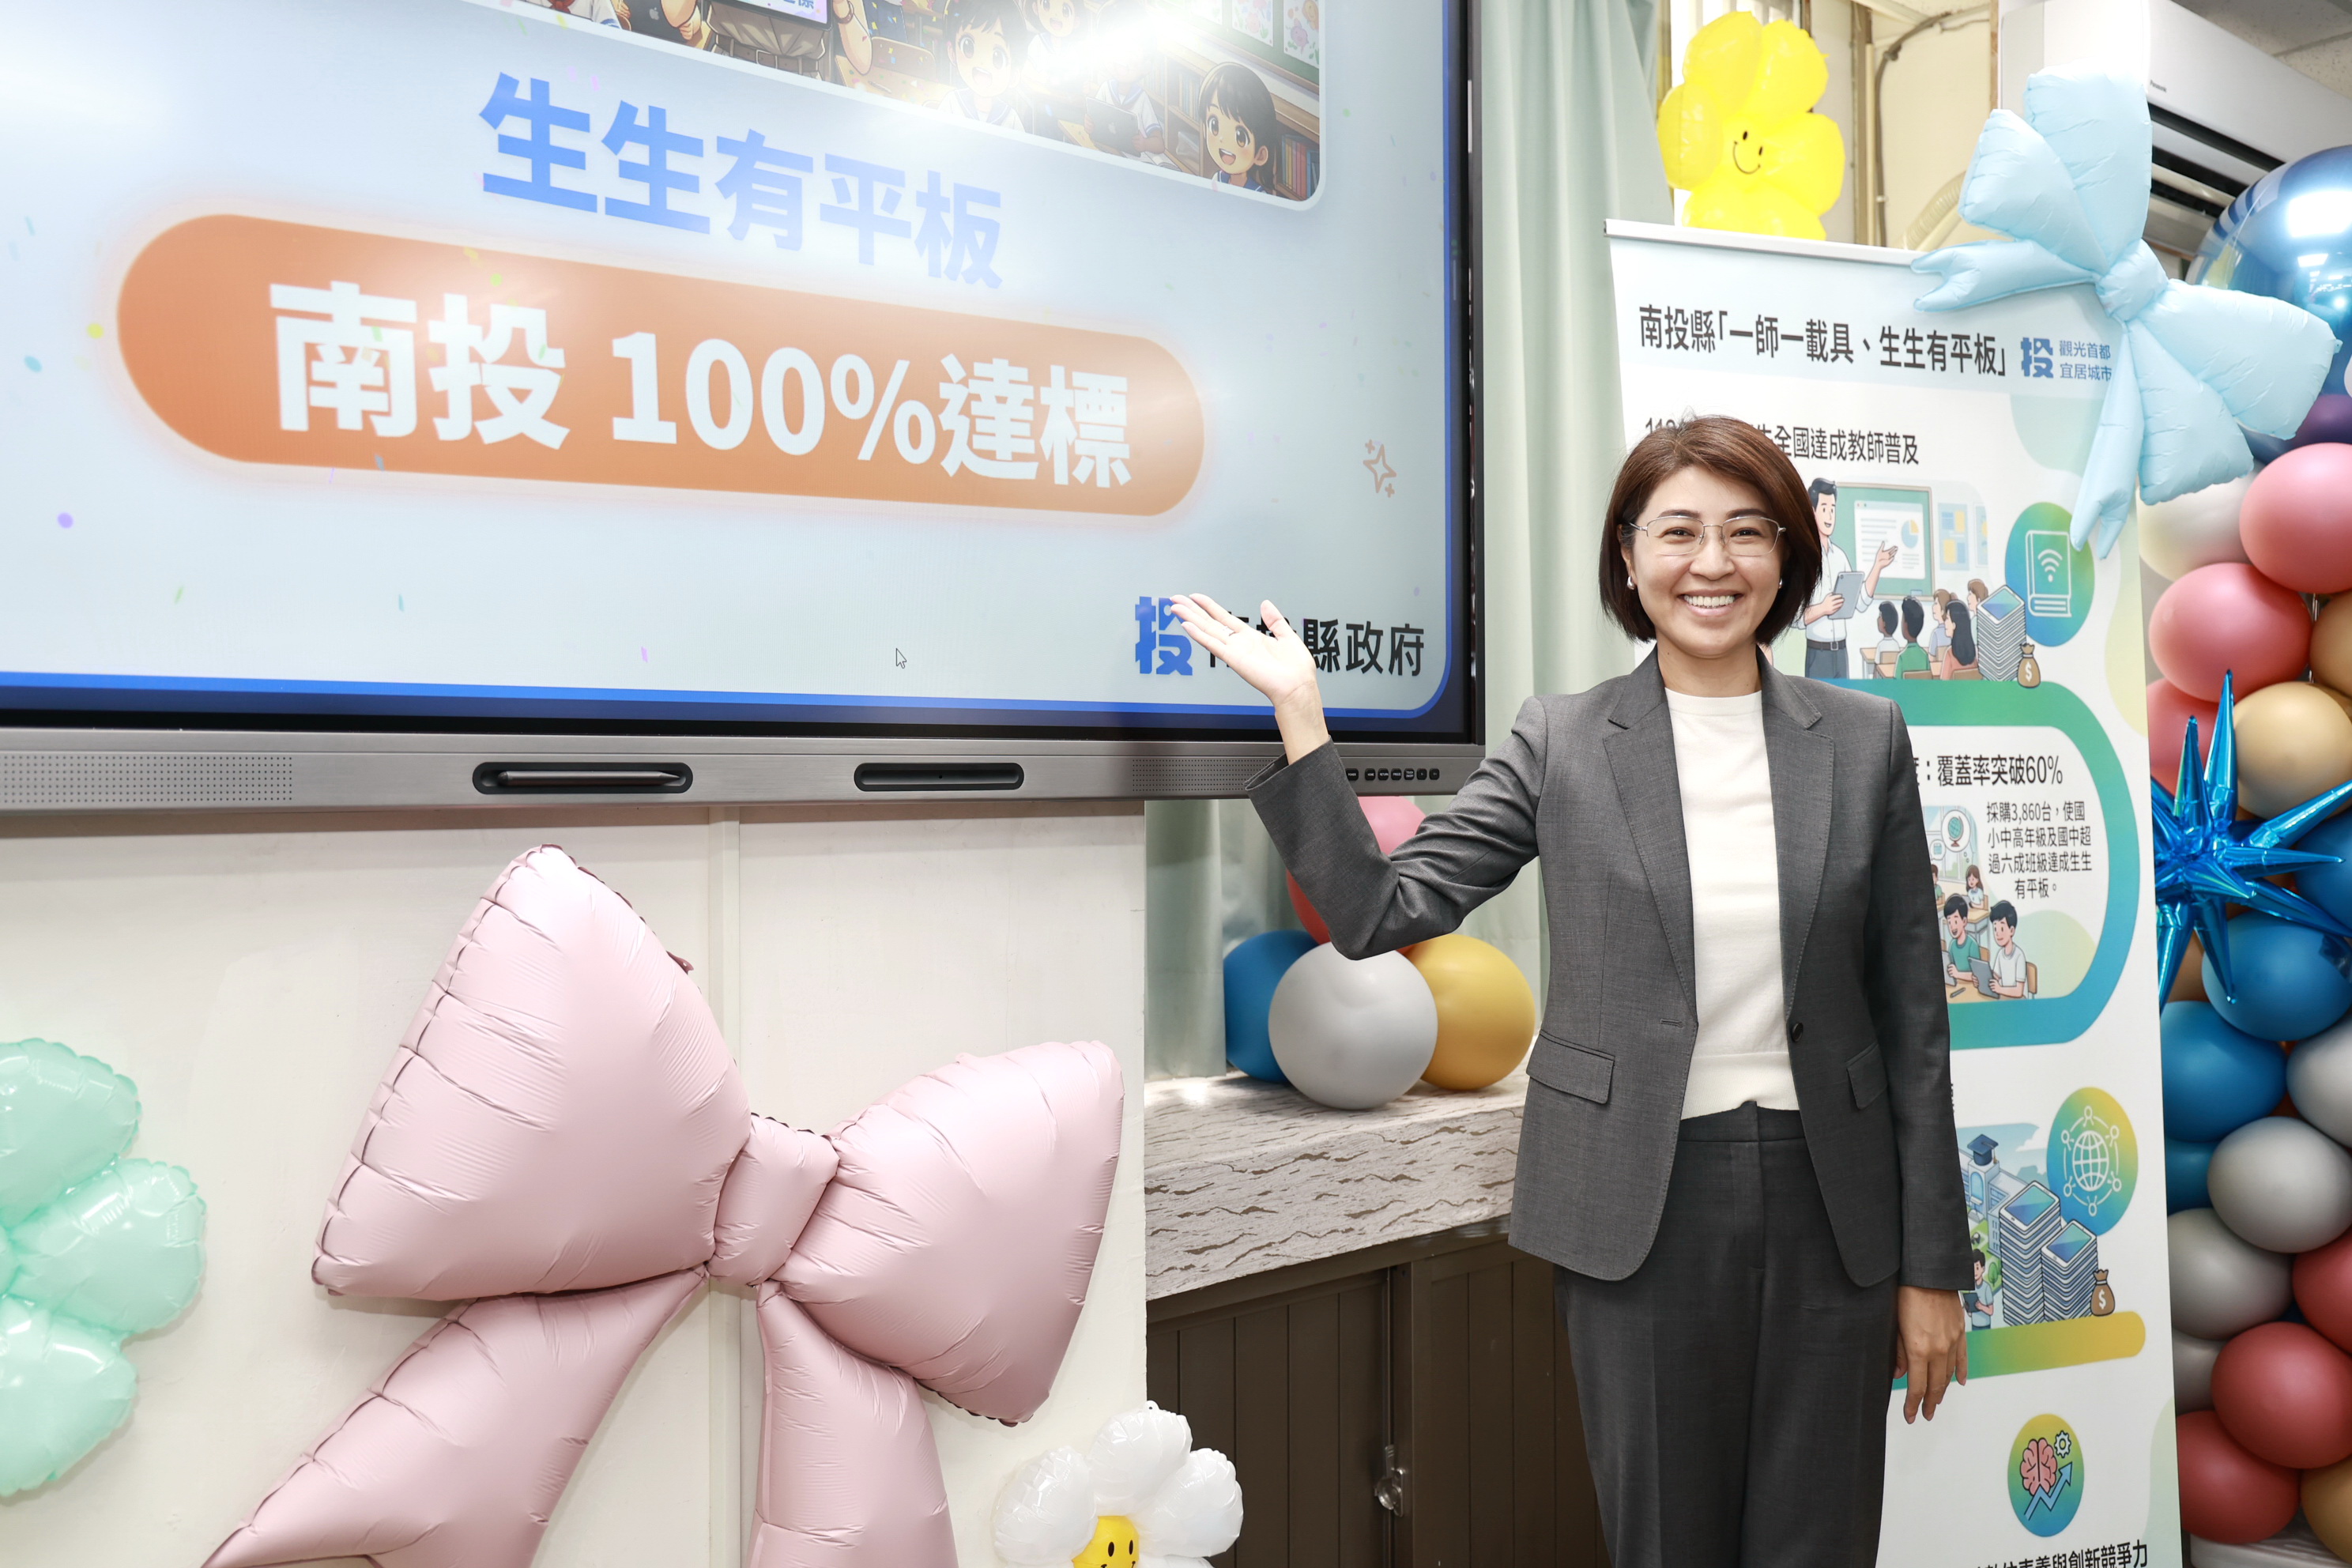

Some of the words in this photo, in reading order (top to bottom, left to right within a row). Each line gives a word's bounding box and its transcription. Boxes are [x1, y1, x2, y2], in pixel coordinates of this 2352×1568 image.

[479, 72, 1003, 289] 生生有平板
[1639, 304, 2006, 376] 南投縣「一師一載具、生生有平板」
[2059, 340, 2111, 360] 觀光首都
[270, 280, 569, 450] 南投
[612, 331, 1133, 488] 100%達標
[2060, 362, 2112, 382] 宜居城市
[1756, 424, 1919, 465] 全國達成教師普及
[1209, 611, 1425, 677] 縣政府
[1986, 801, 2086, 825] 採購3,860台，使國
[1988, 825, 2092, 849] 小中高年級及國中超
[1988, 850, 2093, 874] 過六成班級達成生生
[2015, 877, 2057, 899] 有平板。
